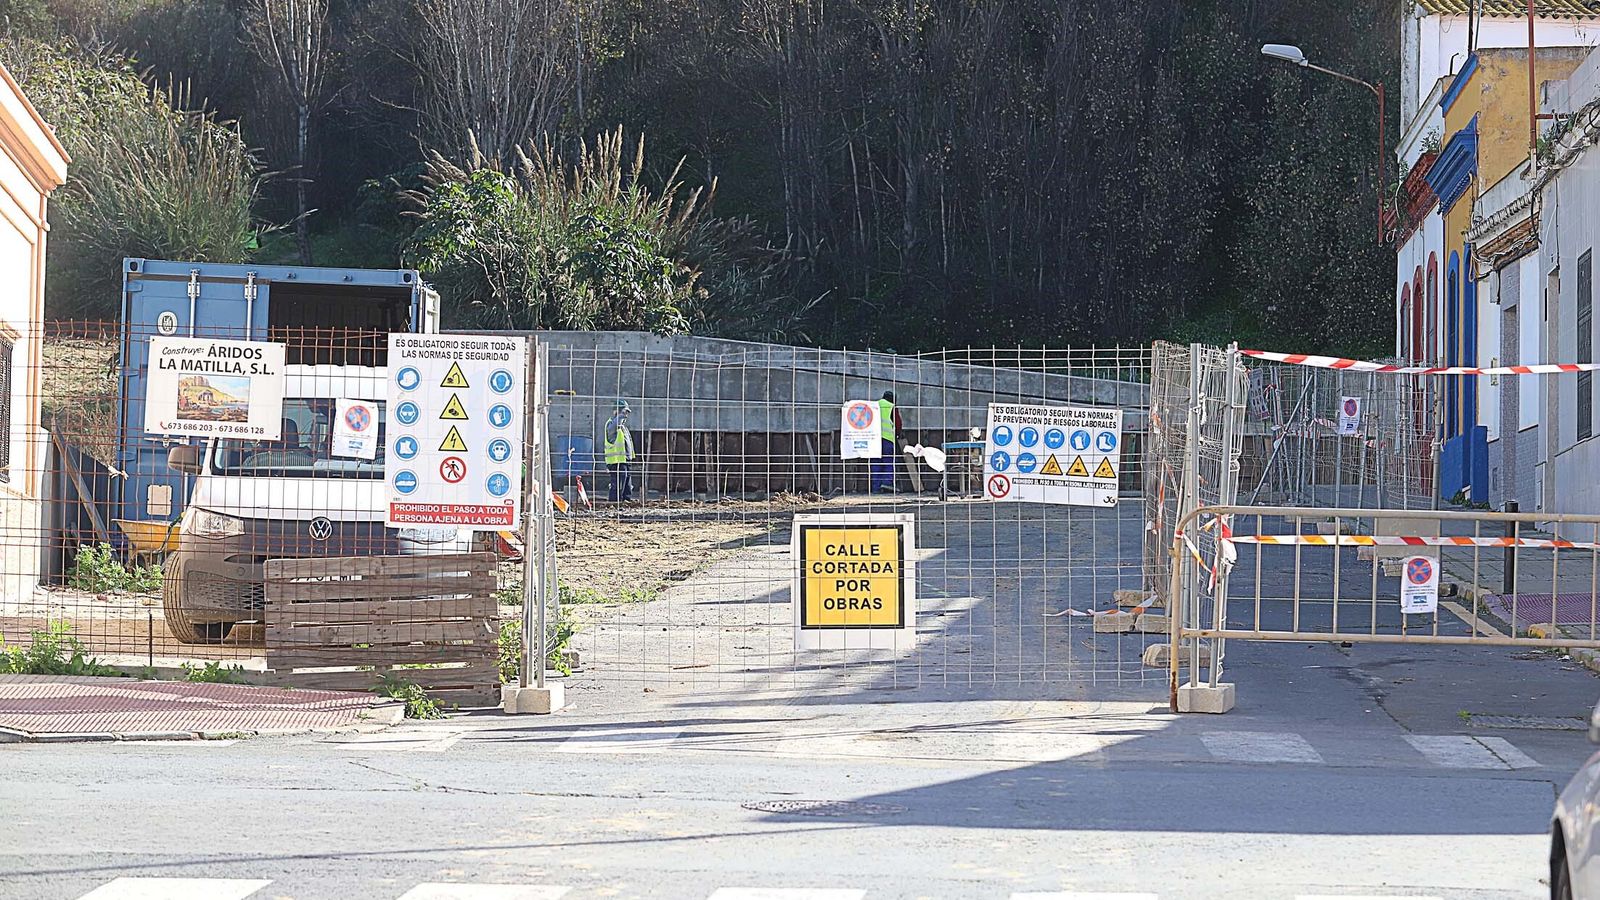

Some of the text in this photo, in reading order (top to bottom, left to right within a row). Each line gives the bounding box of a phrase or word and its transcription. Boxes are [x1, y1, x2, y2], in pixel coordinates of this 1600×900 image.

[396, 339, 516, 351] ES OBLIGATORIO SEGUIR TODAS
[162, 344, 262, 360] Construye: ÁRIDOS
[402, 350, 510, 362] LAS NORMAS DE SEGURIDAD
[159, 358, 274, 375] LA MATILLA, S.L.
[996, 406, 1114, 420] ES OBLIGATORIO SEGUIR LAS NORMAS
[993, 415, 1001, 423] DE
[1044, 418, 1052, 426] DE
[1053, 418, 1080, 428] RIESGOS
[1081, 420, 1117, 429] LABORALES
[183, 423, 198, 431] 686
[199, 424, 212, 432] 203
[218, 424, 232, 432] 673
[234, 426, 248, 434] 686
[250, 426, 264, 434] 128
[394, 504, 440, 513] PROHIBIDO
[454, 506, 476, 514] PASO
[486, 507, 508, 515] TODA
[394, 514, 434, 523] PERSONA
[434, 515, 462, 524] AJENA
[484, 516, 508, 524] OBRA
[826, 544, 880, 556] CALLE
[813, 562, 894, 574] CORTADA
[836, 580, 871, 592] POR
[824, 598, 883, 610] OBRAS
